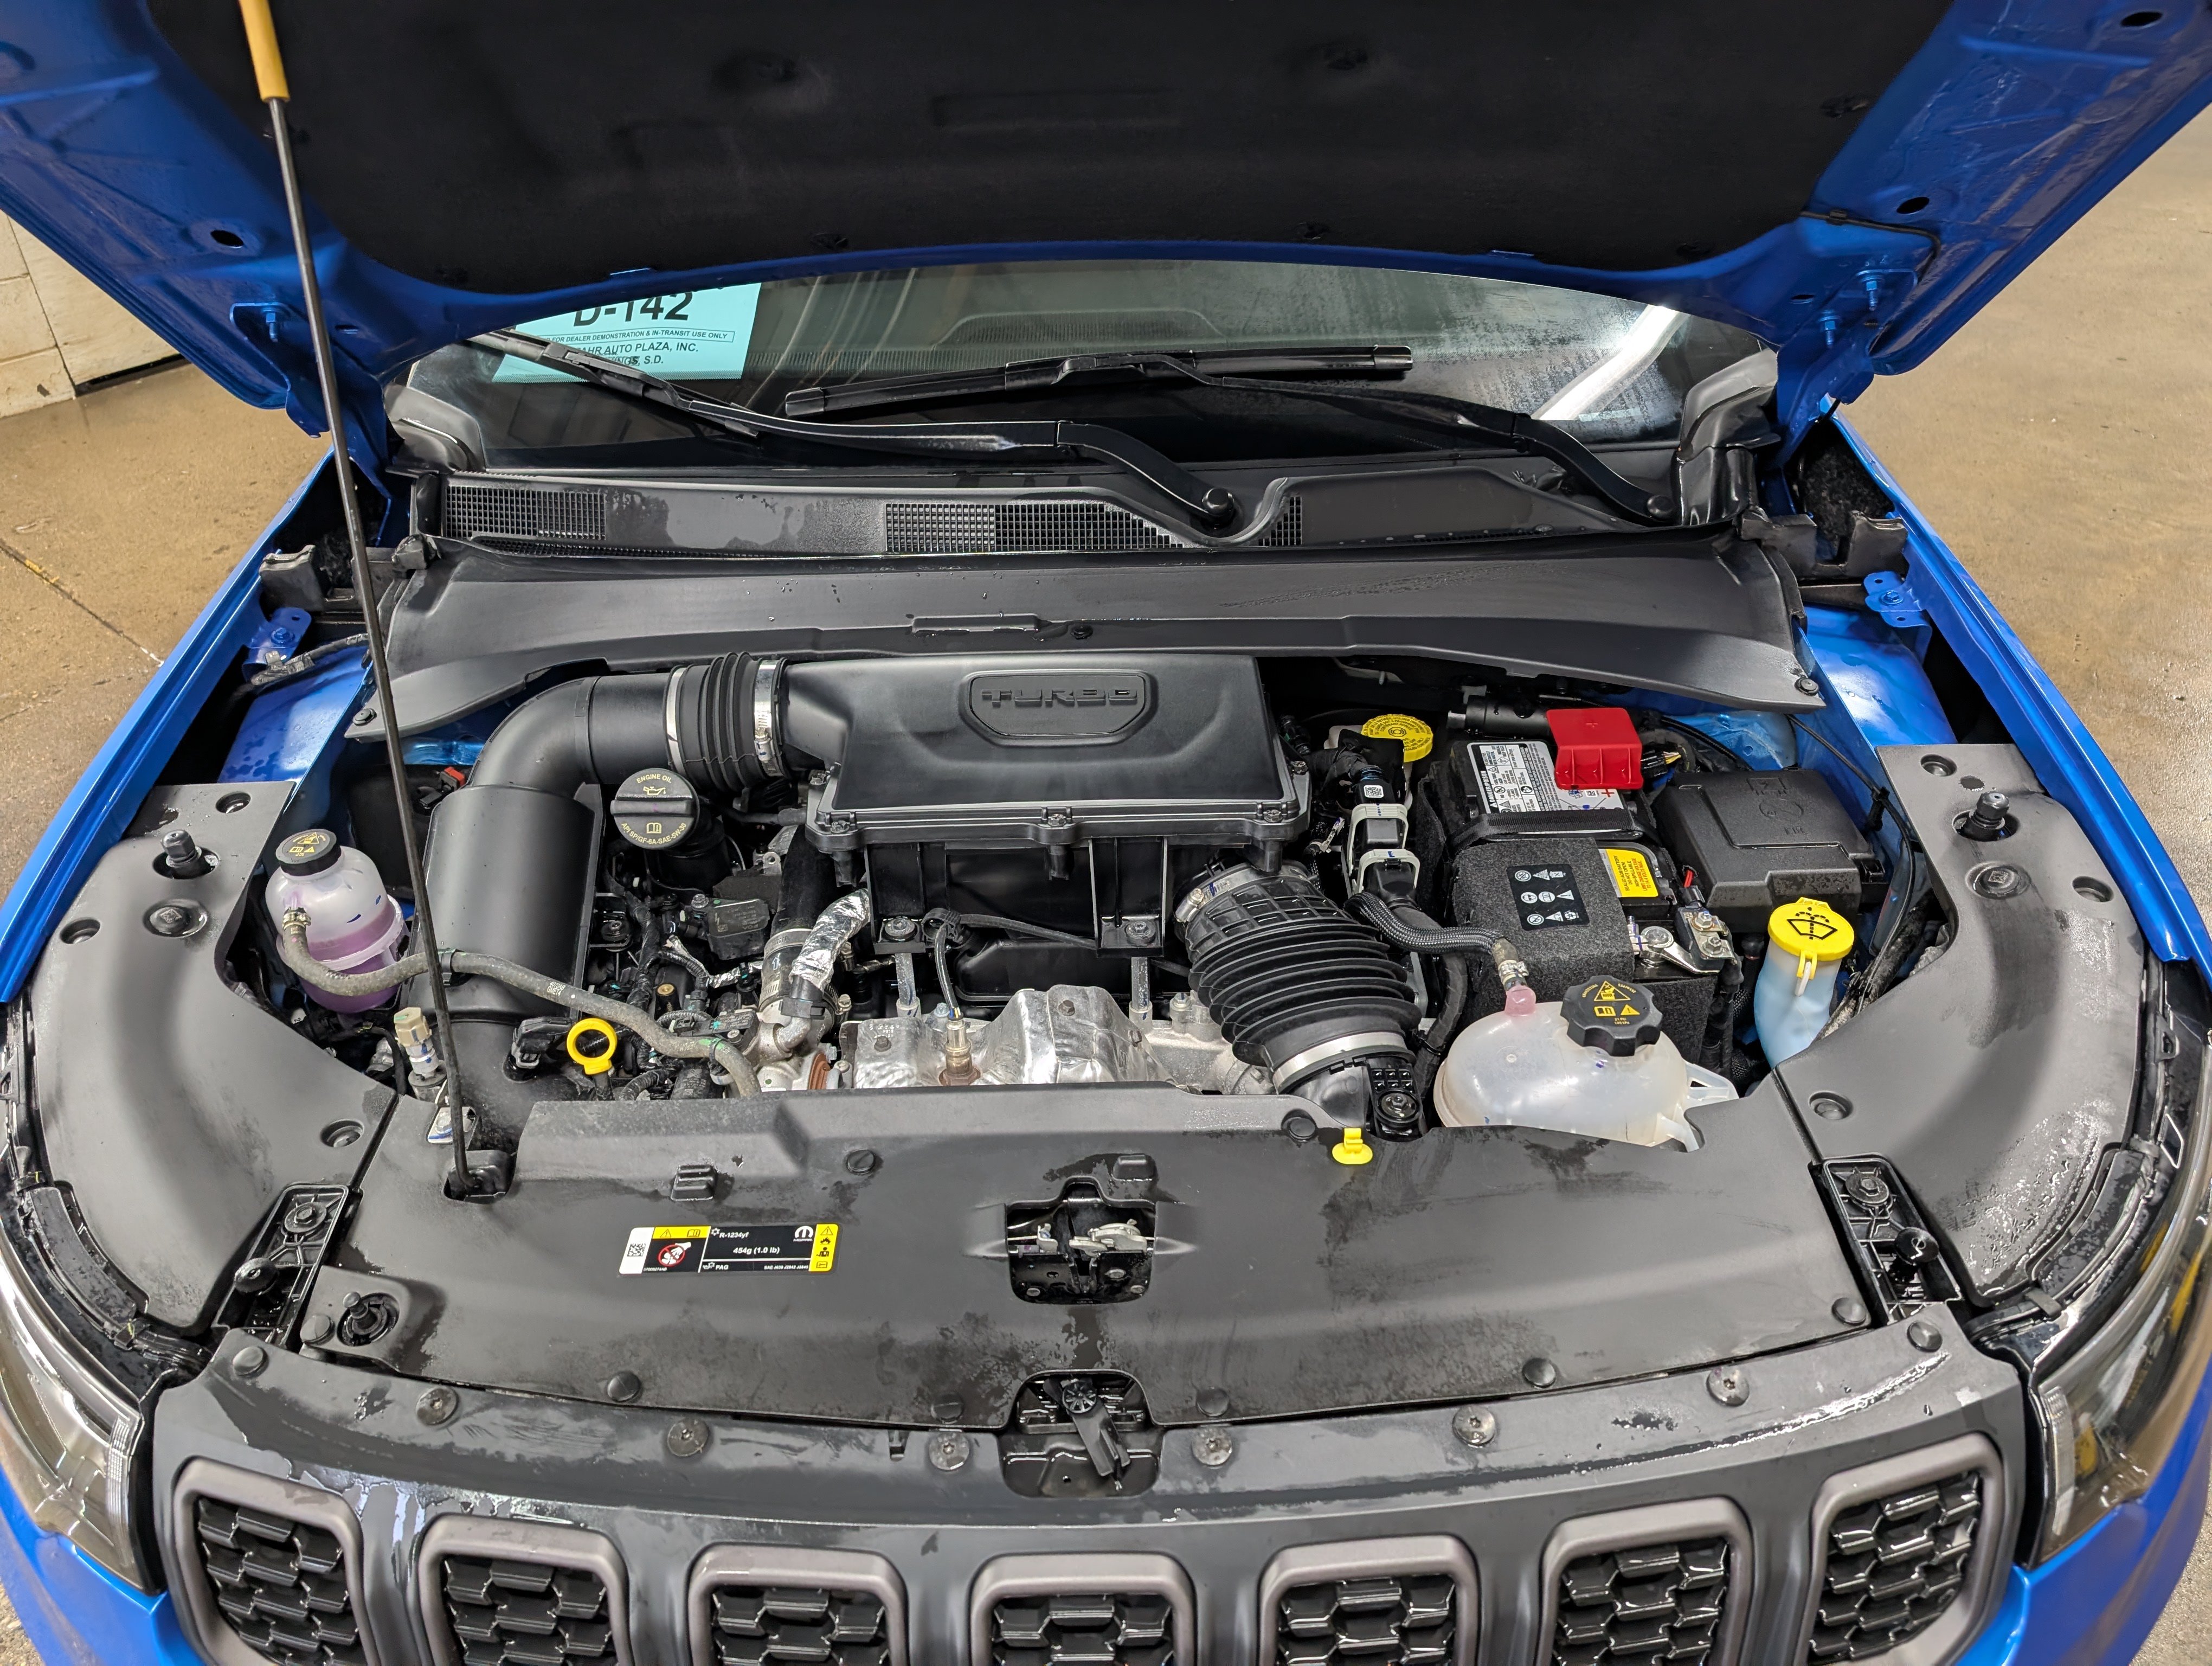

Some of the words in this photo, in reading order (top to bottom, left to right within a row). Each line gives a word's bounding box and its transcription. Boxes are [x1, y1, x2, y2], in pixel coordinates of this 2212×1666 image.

[573, 292, 693, 326] D-142
[593, 330, 644, 341] DEMONSTRATION
[604, 344, 632, 354] AUTO
[635, 342, 672, 352] PLAZA,
[676, 342, 698, 352] INC.
[644, 355, 664, 364] S.D.
[981, 689, 1137, 708] TURBO
[636, 774, 661, 784] ENGINE
[662, 775, 672, 783] OIL
[1481, 771, 1495, 802] DANGER/POISON
[621, 822, 631, 833] API
[754, 1247, 768, 1255] (1.0
